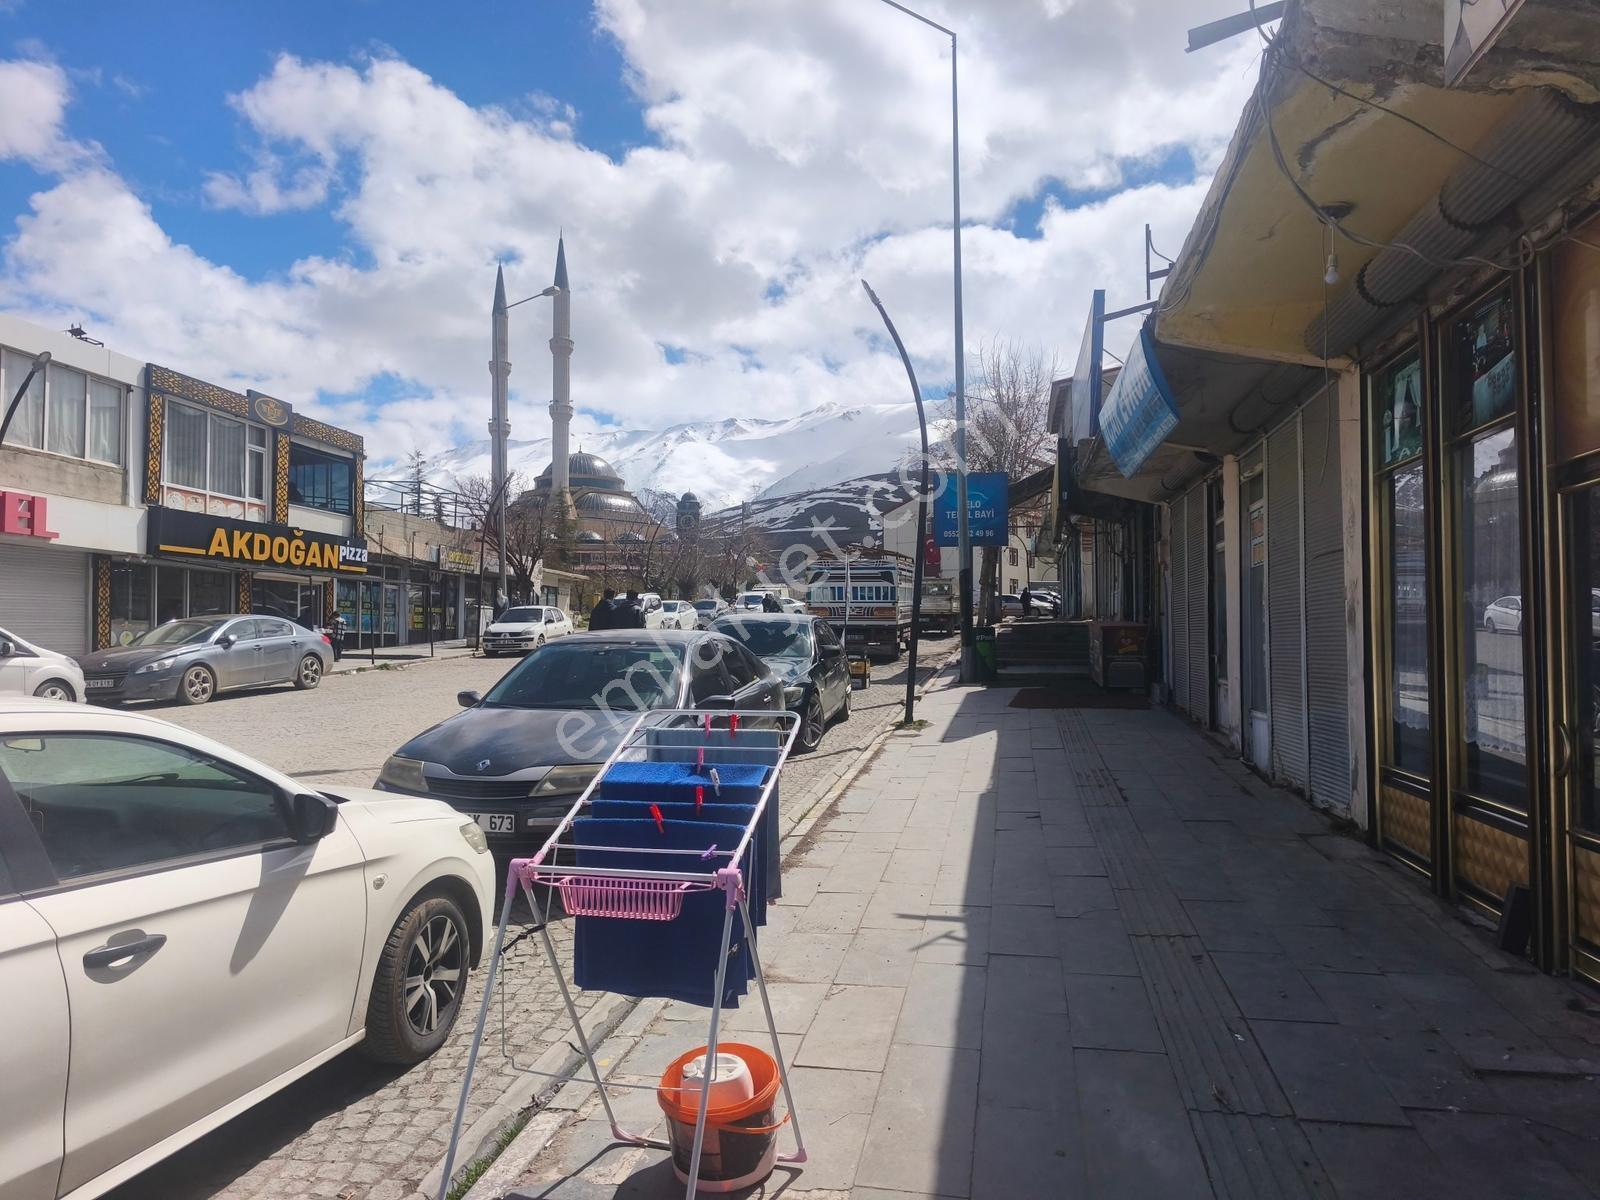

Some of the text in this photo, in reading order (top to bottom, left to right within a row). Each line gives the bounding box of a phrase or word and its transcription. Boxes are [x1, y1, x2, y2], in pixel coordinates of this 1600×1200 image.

[0, 490, 59, 540] EL
[974, 508, 994, 518] BAYİ
[208, 527, 339, 570] AKDOĞAN
[489, 815, 513, 832] 673
